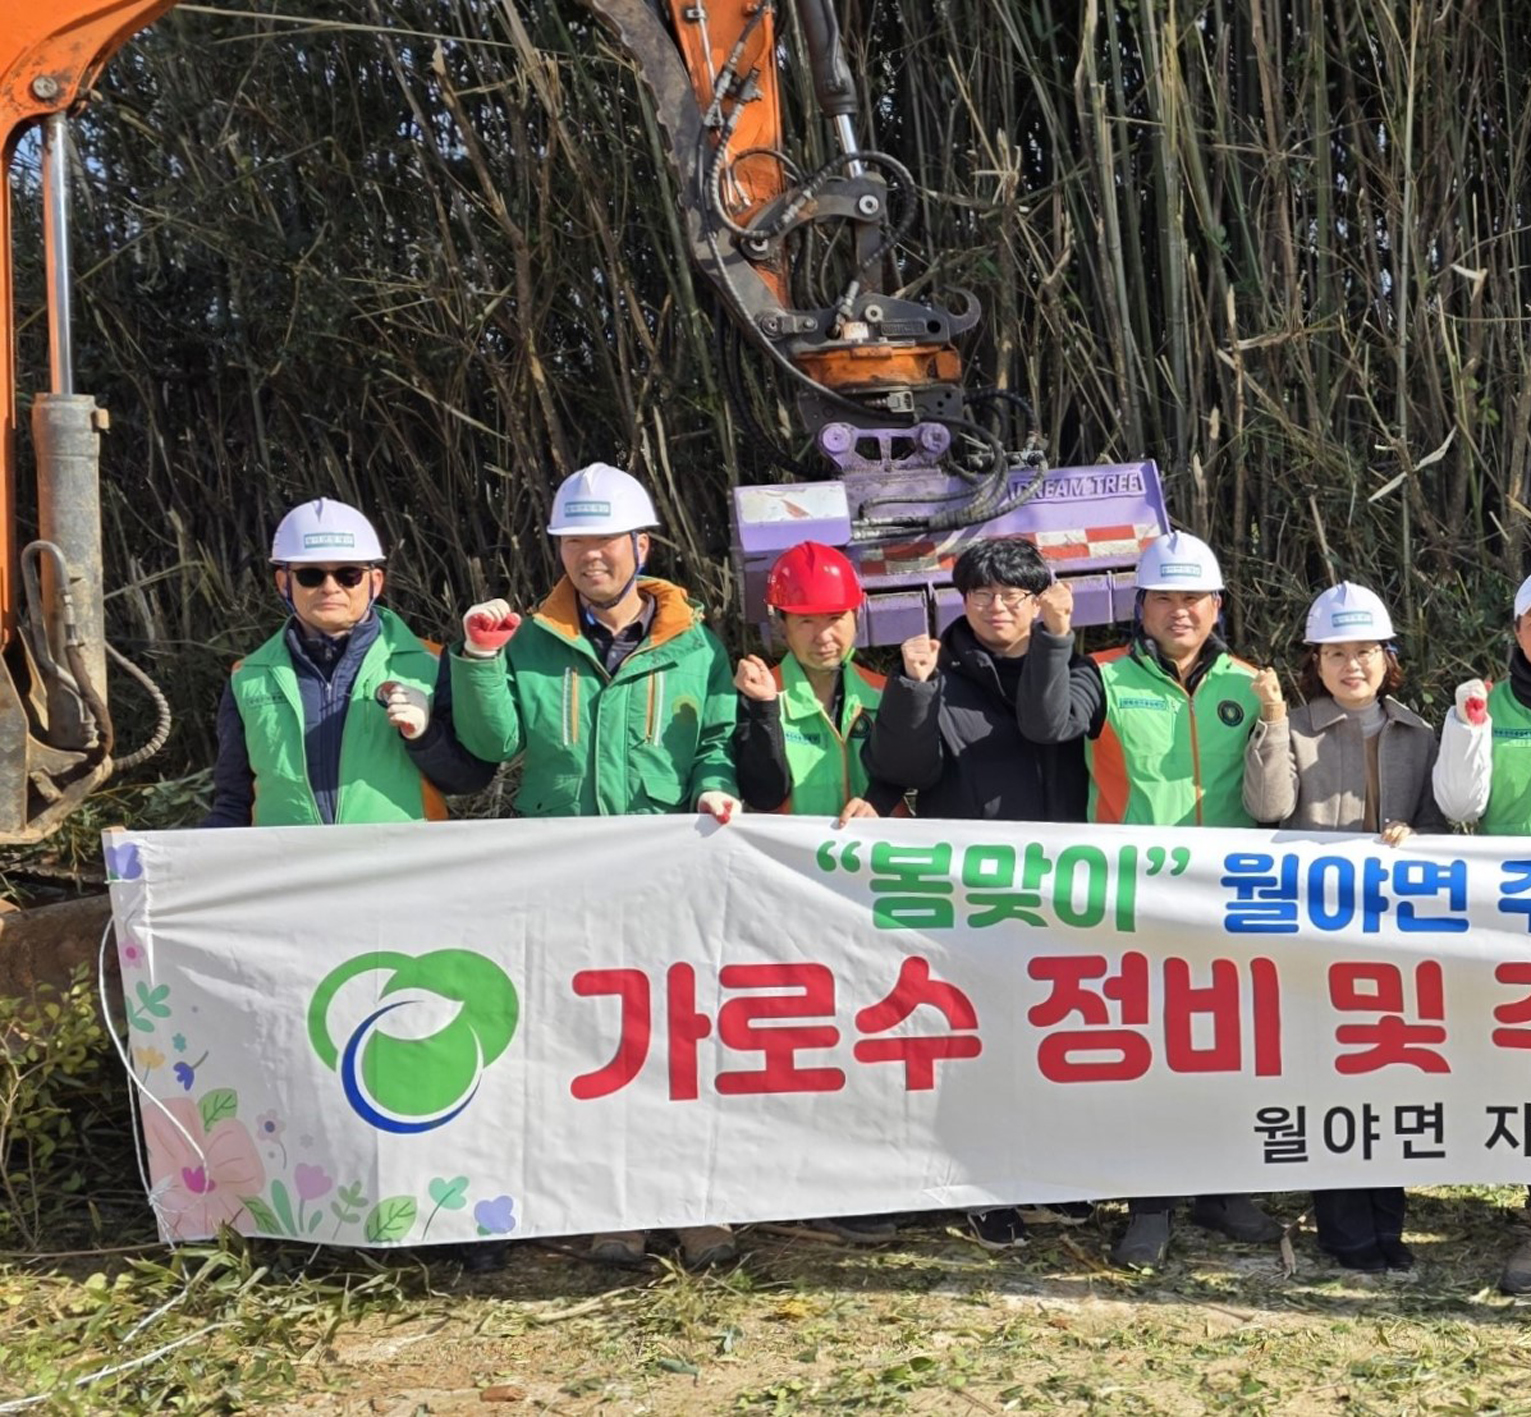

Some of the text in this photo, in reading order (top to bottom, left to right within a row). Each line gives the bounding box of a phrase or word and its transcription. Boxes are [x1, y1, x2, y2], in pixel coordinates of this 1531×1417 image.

[1092, 473, 1139, 495] TREE
[1220, 852, 1469, 934] 월야면
[570, 955, 982, 1101] 가로수
[1027, 951, 1282, 1083] 정비
[1328, 960, 1452, 1076] 및
[1253, 1103, 1447, 1164] 월야면
